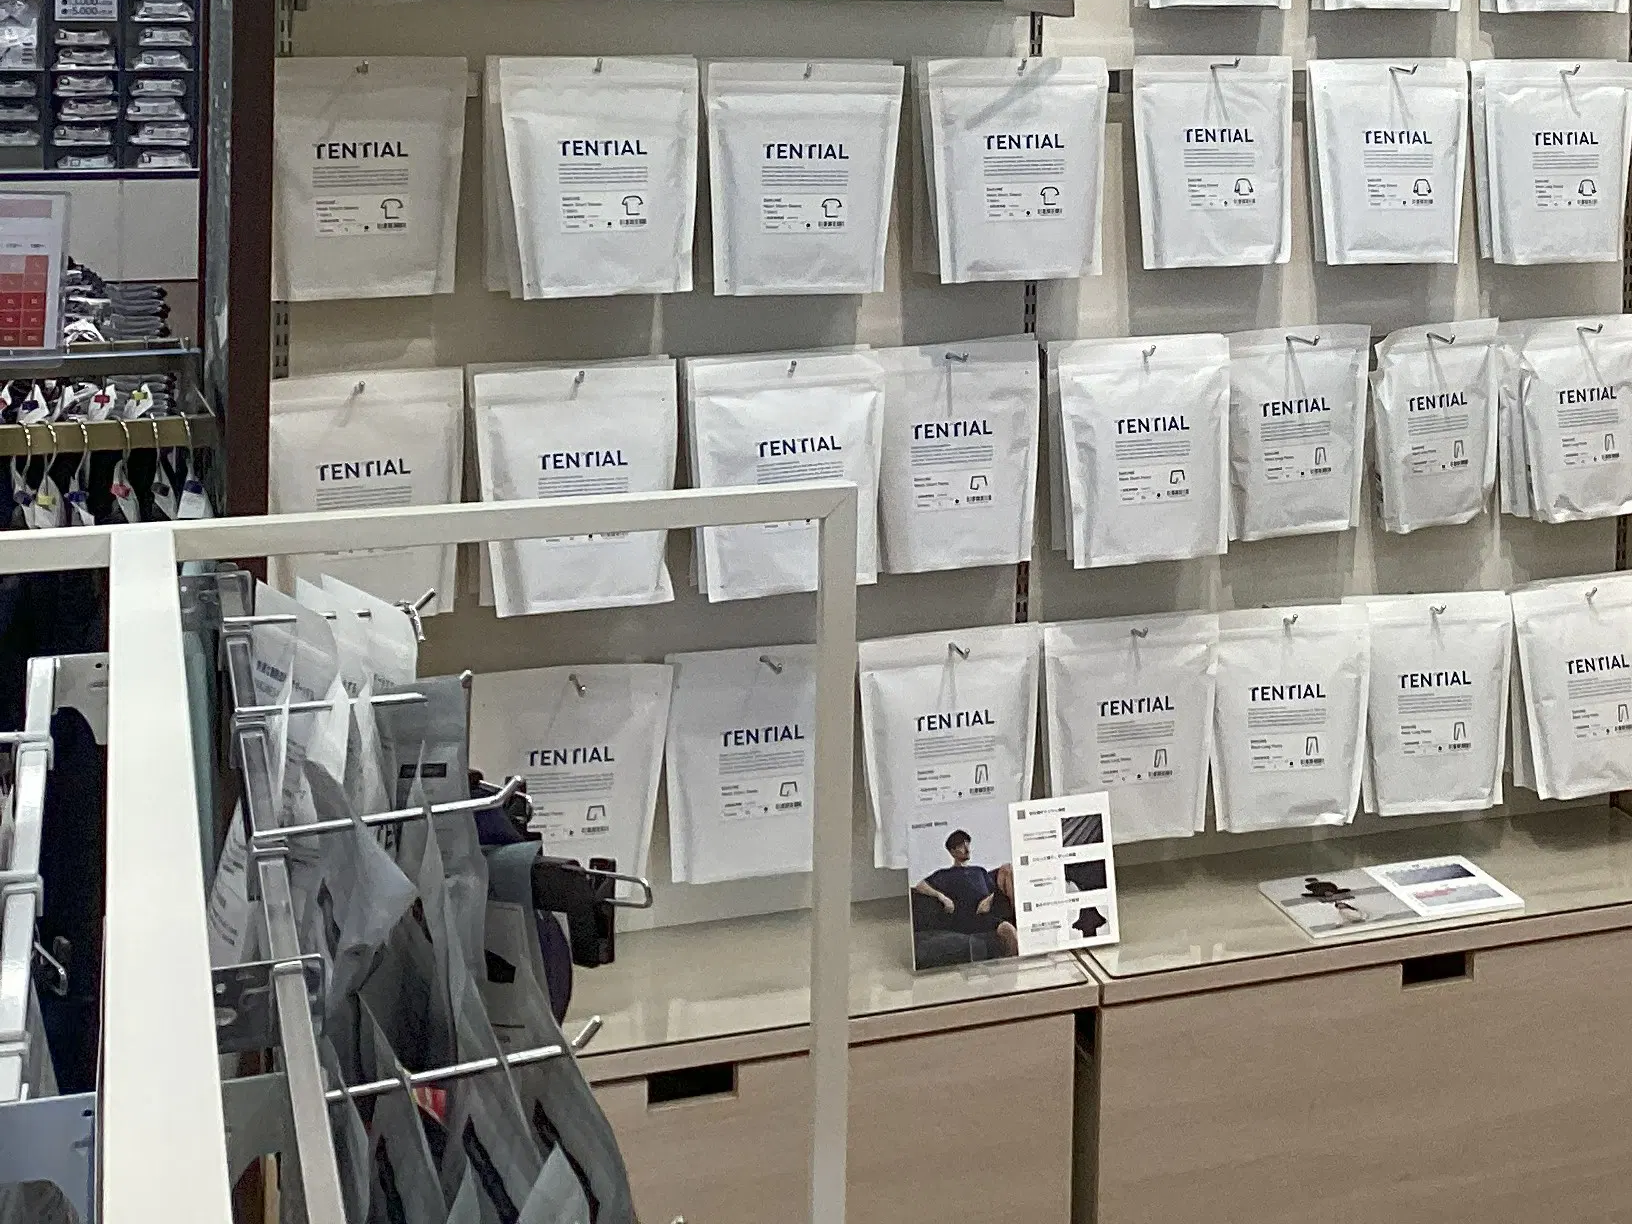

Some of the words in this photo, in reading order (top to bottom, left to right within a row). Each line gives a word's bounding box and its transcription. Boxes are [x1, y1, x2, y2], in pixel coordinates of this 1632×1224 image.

[984, 133, 1065, 150] TENTIAL
[1183, 128, 1254, 143] TENTIAL
[1363, 130, 1433, 145] TENTIAL
[1532, 131, 1599, 146] TENTIAL
[312, 141, 409, 160] TENTIAL
[558, 139, 648, 157] TENTIAL
[763, 143, 849, 160] TENTIAL
[1407, 391, 1468, 412] TENTIAL
[1558, 386, 1617, 405] TENTIAL
[1261, 397, 1331, 418] TENTIAL
[911, 419, 993, 440] TENTIAL
[1116, 415, 1190, 435] TENTIAL
[757, 435, 842, 458] TENTIAL
[317, 458, 411, 481] TENTIAL
[538, 450, 629, 470] TENTIAL
[1566, 654, 1630, 675] TENTIAL
[1399, 670, 1472, 689] TENTIAL
[1249, 683, 1326, 702] TENTIAL
[1097, 695, 1175, 717] TENTIAL
[916, 709, 995, 732] TENTIAL
[722, 724, 805, 747] TENTIAL
[528, 746, 615, 767] TENTIAL
